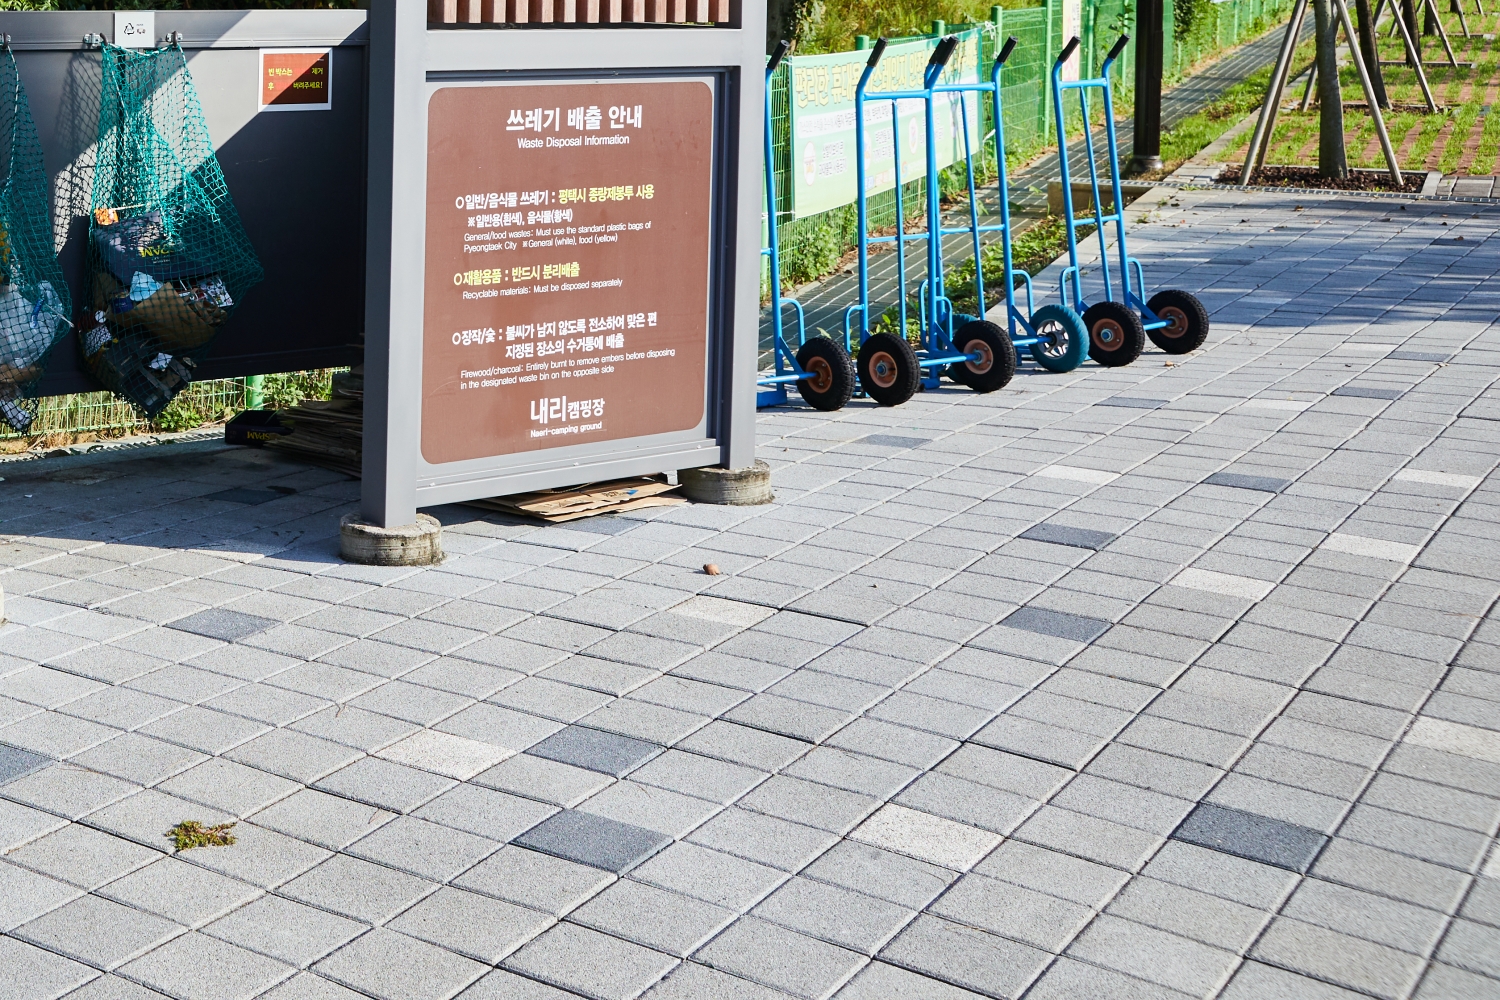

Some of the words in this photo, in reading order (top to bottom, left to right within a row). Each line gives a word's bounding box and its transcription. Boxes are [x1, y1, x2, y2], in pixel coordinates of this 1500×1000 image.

[268, 68, 274, 76] 빈
[276, 68, 292, 76] 박스는
[312, 67, 323, 75] 제거
[268, 82, 274, 90] 후
[293, 81, 323, 89] 버려주세요!
[795, 65, 829, 108] 편리한
[831, 62, 862, 104] 휴대용
[506, 107, 560, 132] 쓰레기
[567, 105, 602, 130] 배출
[608, 104, 643, 129] 안내
[517, 137, 543, 149] Waste
[546, 135, 582, 148] Disposal
[584, 134, 629, 146] Information
[520, 191, 548, 205] 쓰레기
[559, 188, 586, 204] 평택시
[589, 186, 633, 202] 종량제봉투
[636, 184, 654, 199] 사용
[464, 231, 506, 242] General/food
[536, 228, 551, 236] Must
[578, 224, 605, 233] standard
[607, 223, 626, 232] plastic
[628, 222, 643, 231] bags
[645, 221, 651, 229] of
[464, 242, 502, 253] Pyeongtaek
[505, 241, 516, 251] City
[579, 235, 592, 244] food
[595, 233, 618, 244] (yellow)
[512, 265, 539, 282] 반드시
[543, 262, 580, 278] 분리배출
[463, 289, 498, 300] Recyclable
[500, 287, 530, 296] materials:
[534, 285, 548, 293] Must
[561, 281, 589, 291] disposed
[591, 278, 623, 288] separately
[506, 323, 534, 341] 불씨가
[537, 321, 556, 339] 남지
[559, 319, 586, 336] 않도록
[589, 315, 624, 332] 전소하여
[627, 312, 645, 329] 맞은
[648, 311, 657, 326] 편
[505, 342, 534, 360] 지정된
[537, 339, 564, 357] 장소의
[567, 335, 603, 354] 수거통에
[606, 333, 624, 348] 배출
[461, 364, 523, 379] Firewood/charcoal:
[526, 361, 548, 372] Entirely
[551, 360, 567, 369] burnt
[569, 359, 574, 367] to
[577, 357, 599, 366] remove
[601, 354, 624, 364] embers
[626, 352, 644, 361] before
[647, 348, 675, 360] disposing
[461, 381, 467, 389] in
[469, 380, 479, 388] the
[481, 376, 517, 388] designated
[519, 374, 537, 383] waste
[540, 372, 549, 381] bin
[562, 370, 571, 378] the
[574, 367, 599, 378] opposite
[602, 365, 614, 374] side
[531, 396, 605, 424] 내리캠핑장
[580, 421, 602, 434] ground
